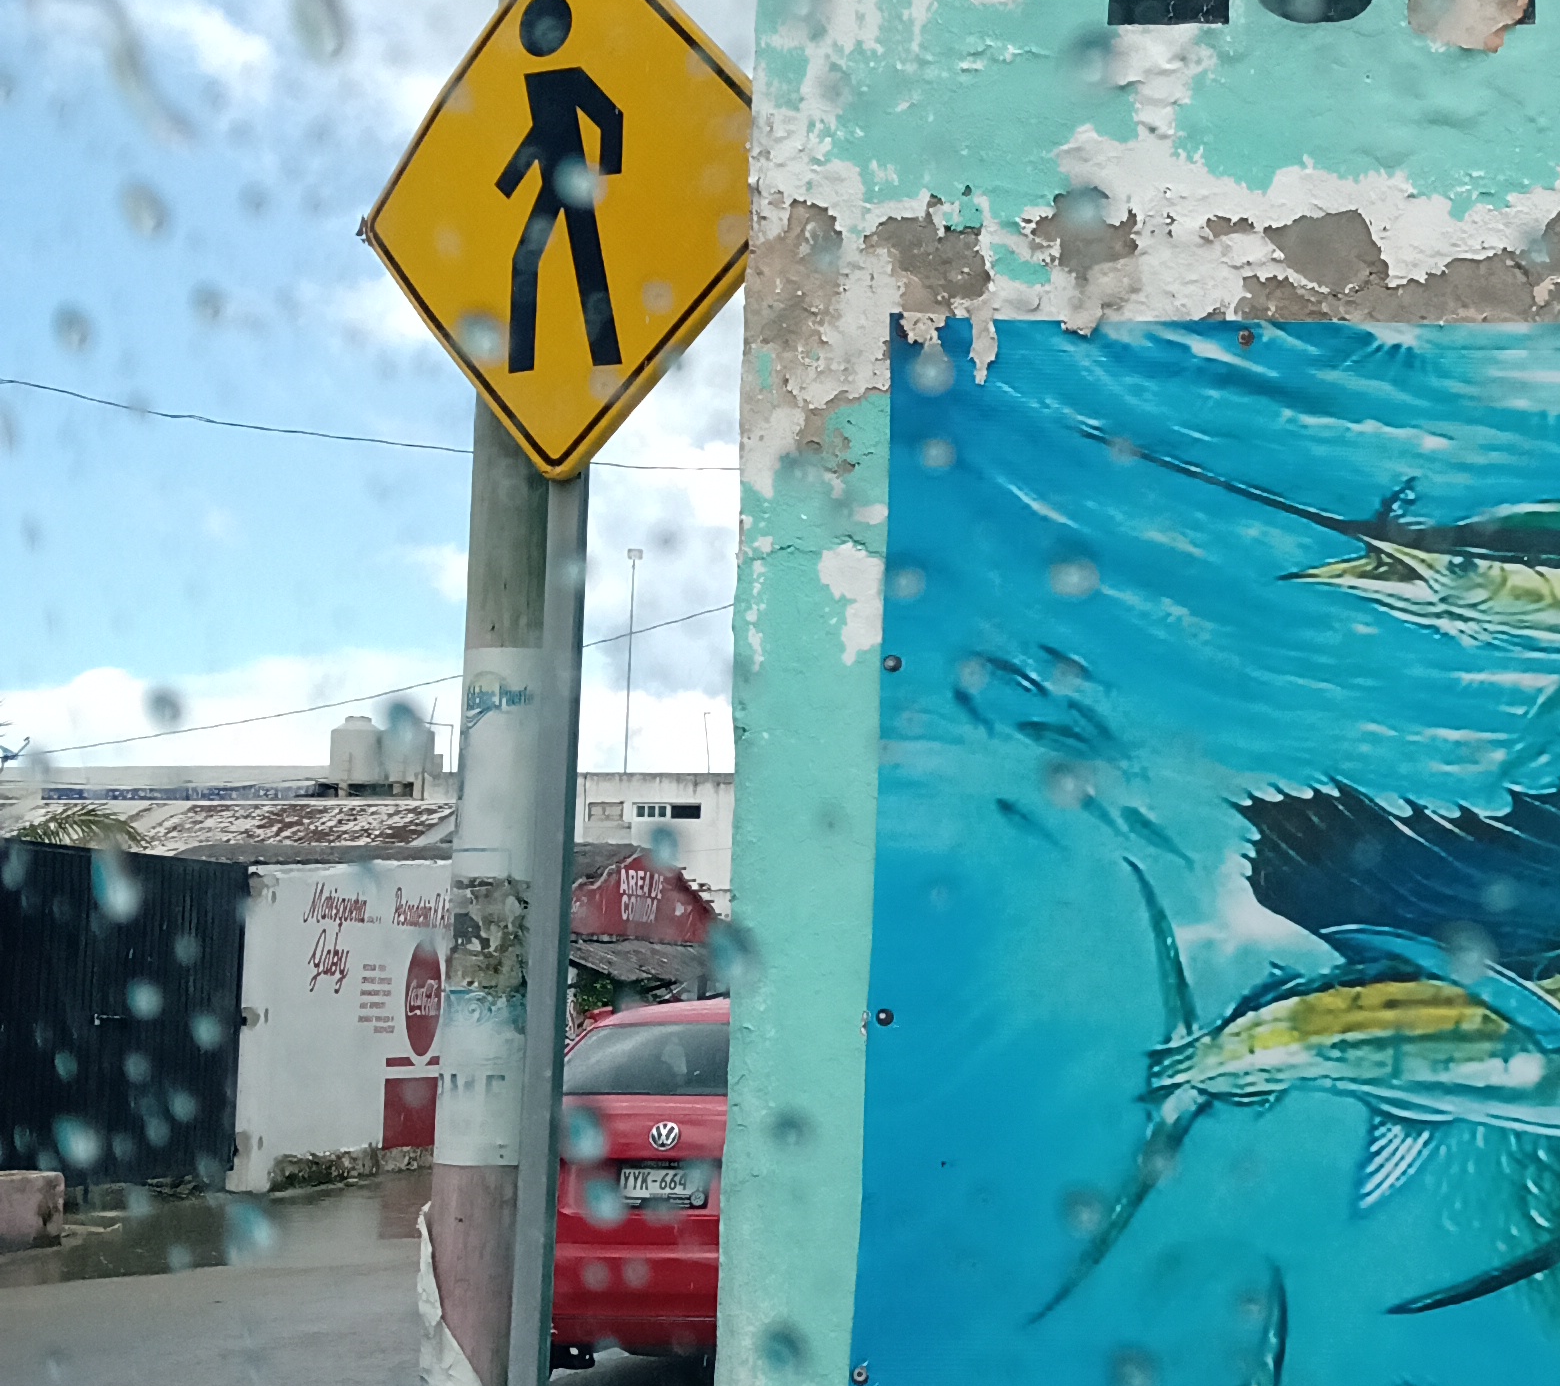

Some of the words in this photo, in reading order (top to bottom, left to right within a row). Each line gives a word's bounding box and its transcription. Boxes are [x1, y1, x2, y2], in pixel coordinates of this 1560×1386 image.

[620, 868, 650, 896] AREA
[651, 873, 664, 900] DE
[623, 1169, 691, 1192] YYK-664
